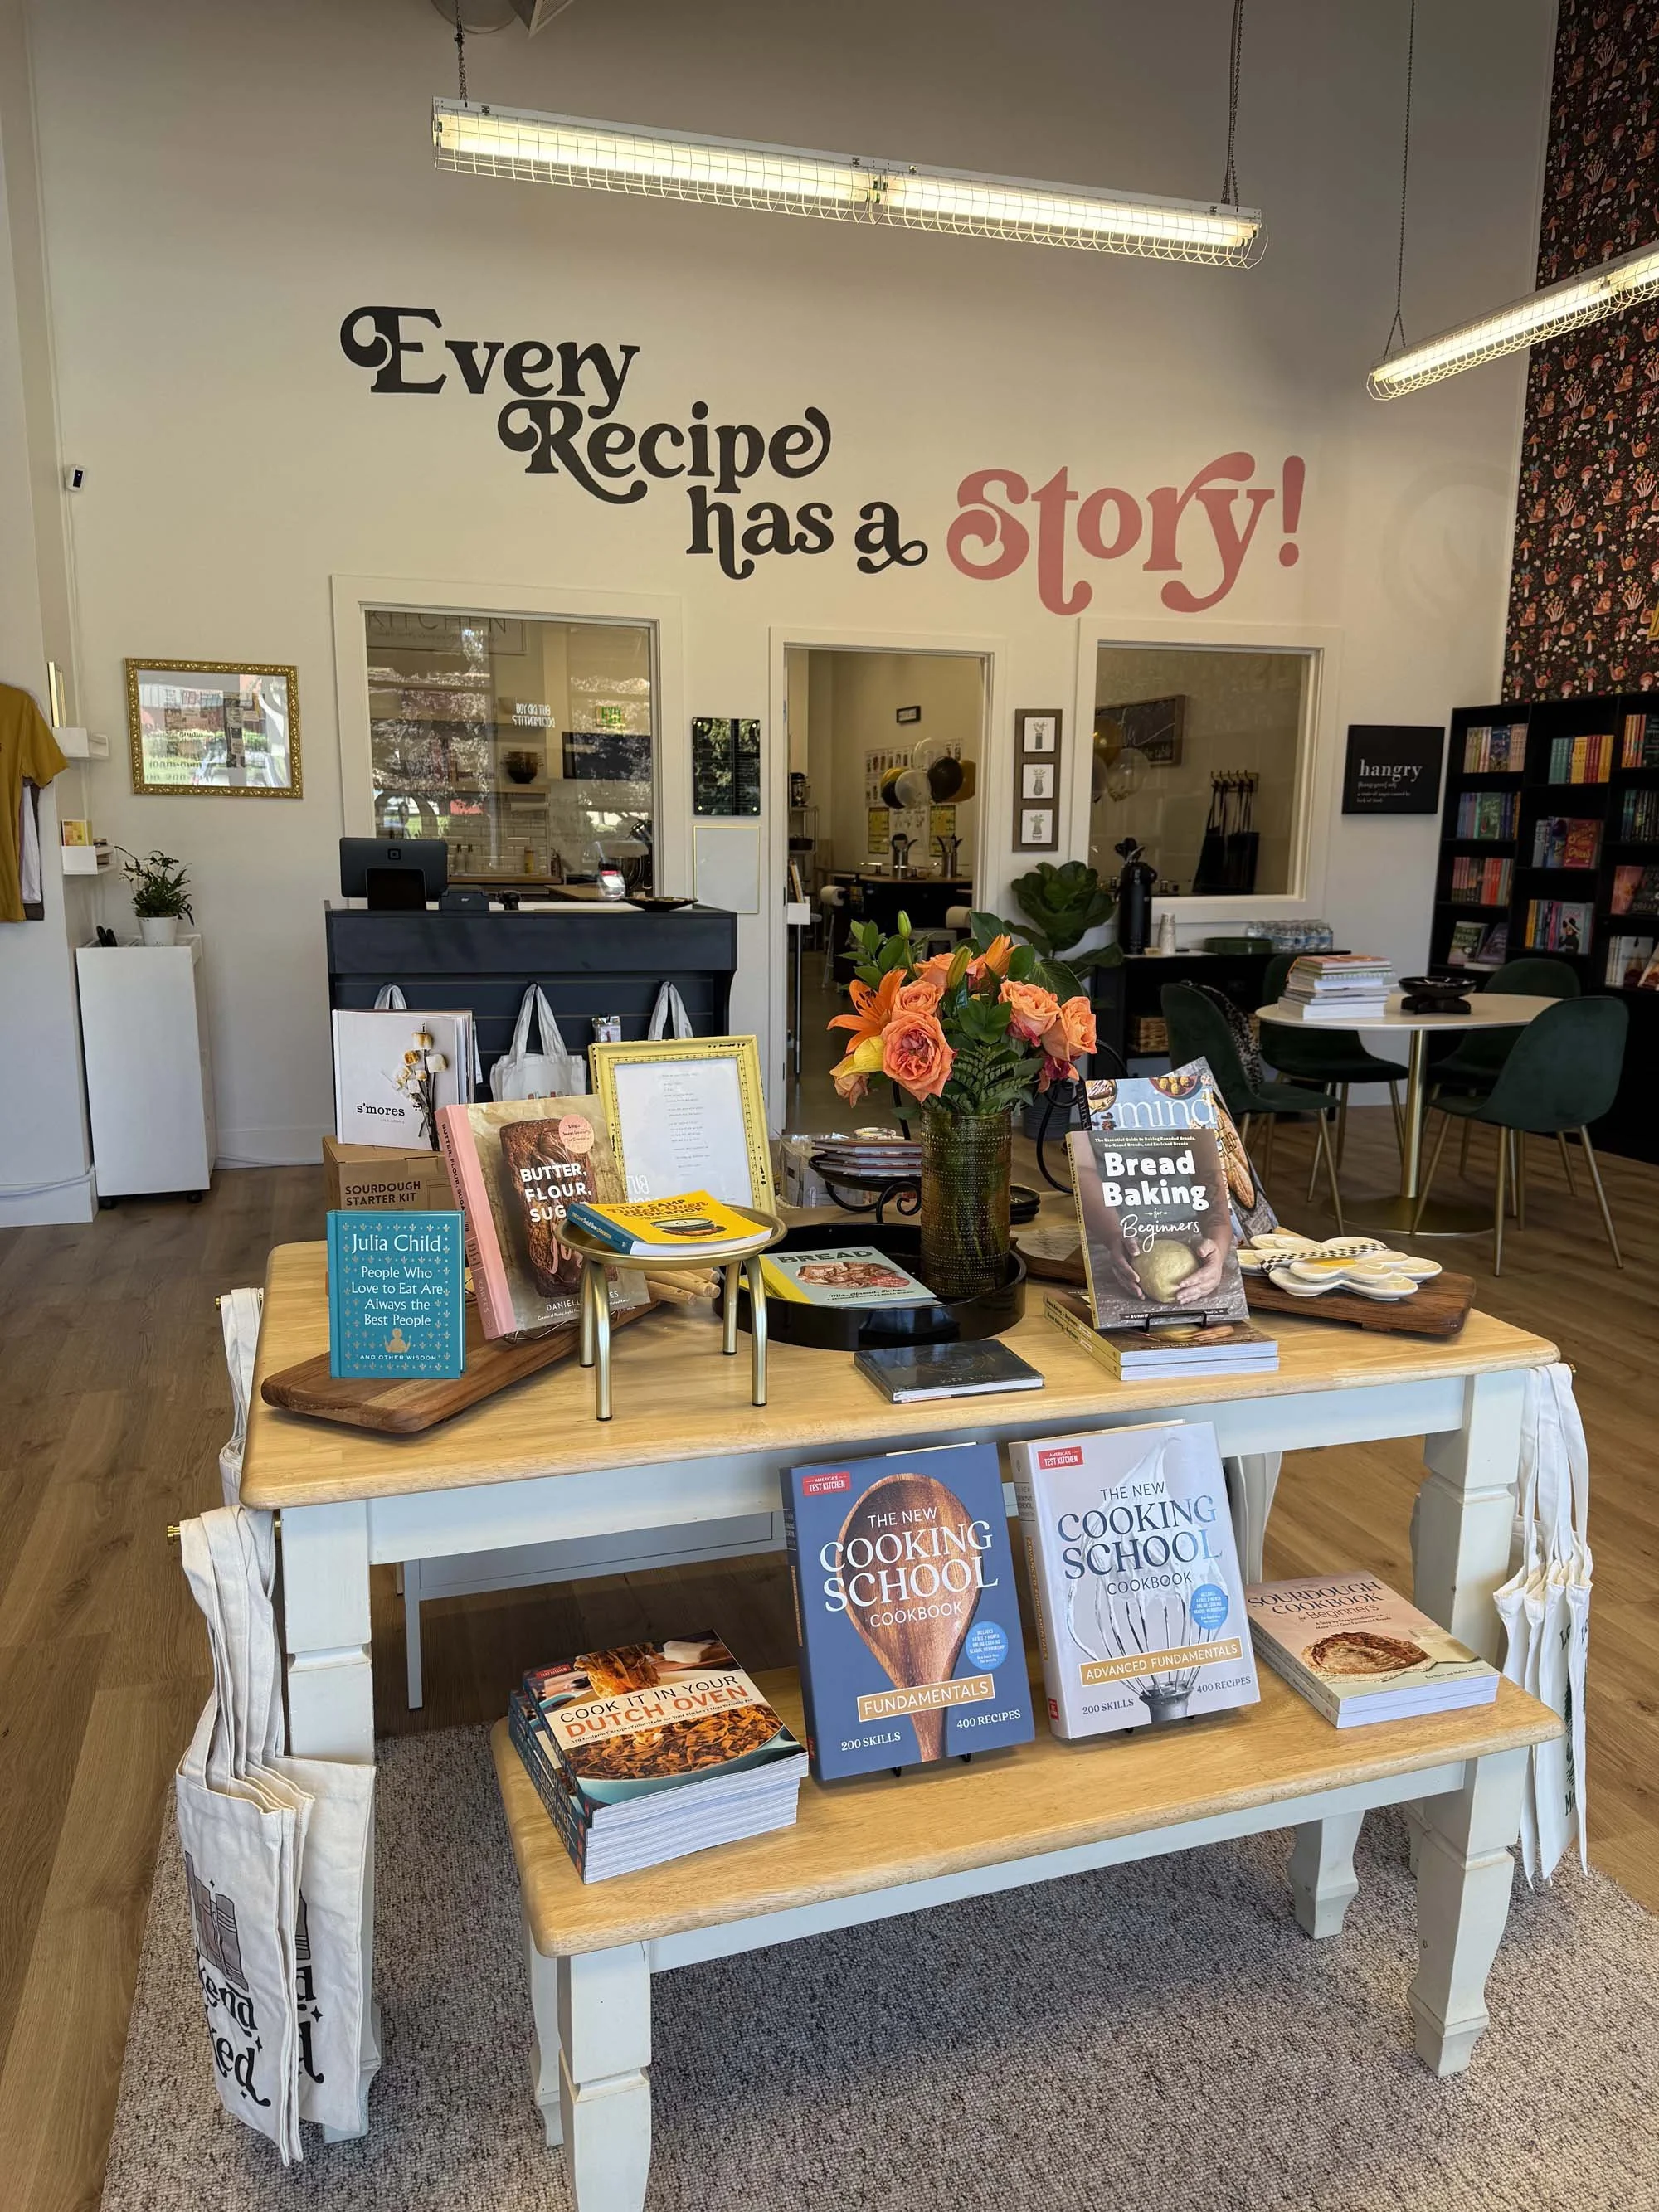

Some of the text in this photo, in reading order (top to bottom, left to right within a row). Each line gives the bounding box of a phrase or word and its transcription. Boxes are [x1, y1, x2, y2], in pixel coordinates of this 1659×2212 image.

[340, 305, 640, 420] Every
[498, 399, 831, 505] Recipe
[686, 451, 1306, 615] has a Story!
[1359, 758, 1423, 782] hangry
[357, 1102, 405, 1116] s'mores
[1115, 1088, 1217, 1129] mind
[520, 1162, 587, 1183] BUTTER,
[1104, 1150, 1196, 1177] Bread
[345, 1181, 421, 1194] SOURDOUGH
[524, 1182, 591, 1203] FLOUR,
[1102, 1179, 1209, 1212] Baking
[347, 1193, 416, 1206] STARTER KIT
[606, 1201, 709, 1216] Dutch Oven
[648, 1199, 685, 1208] CAMP
[529, 1204, 567, 1223] SUG
[623, 1207, 707, 1217] COOKBOOK
[1120, 1213, 1201, 1253] Beginners
[352, 1234, 440, 1253] Julia Child
[776, 1250, 873, 1264] BREAD
[361, 1266, 432, 1280] People Who
[352, 1282, 443, 1295] Love to Eat Are
[364, 1299, 431, 1310] Always the
[546, 1298, 581, 1311] DANIELL
[364, 1314, 431, 1327] Best People
[1044, 1455, 1078, 1467] TEST KITCHEN
[809, 1479, 845, 1492] TEST KITCHEN
[1100, 1481, 1165, 1500] THE NEW
[867, 1506, 938, 1529] THE NEW
[1058, 1495, 1217, 1543] COOKING
[820, 1520, 993, 1573] COOKING
[1062, 1528, 1223, 1579] SCHOOL
[824, 1555, 998, 1612] SCHOOL
[1107, 1572, 1193, 1596] COOKBOOK
[1248, 1582, 1384, 1608] SOURDOUGH
[1272, 1592, 1384, 1616] COOKBOOK
[870, 1602, 963, 1628] COOKBOOK
[1306, 1604, 1379, 1619] Beginners
[1086, 1660, 1148, 1680] ADVANCED
[1151, 1644, 1238, 1668] FUNDAMENTALS
[1196, 1676, 1251, 1694] 400 RECIPES
[560, 1675, 738, 1723] COOK IT IN YOUR
[864, 1681, 989, 1715] FUNDAMENTALS
[1082, 1698, 1134, 1715] 200 SKILLS
[565, 1685, 749, 1738] DUTCH OVEN
[956, 1709, 1021, 1729] 400 RECIPES
[630, 1719, 662, 1729] Tailor-Made
[840, 1732, 902, 1752] 200 SKILLS
